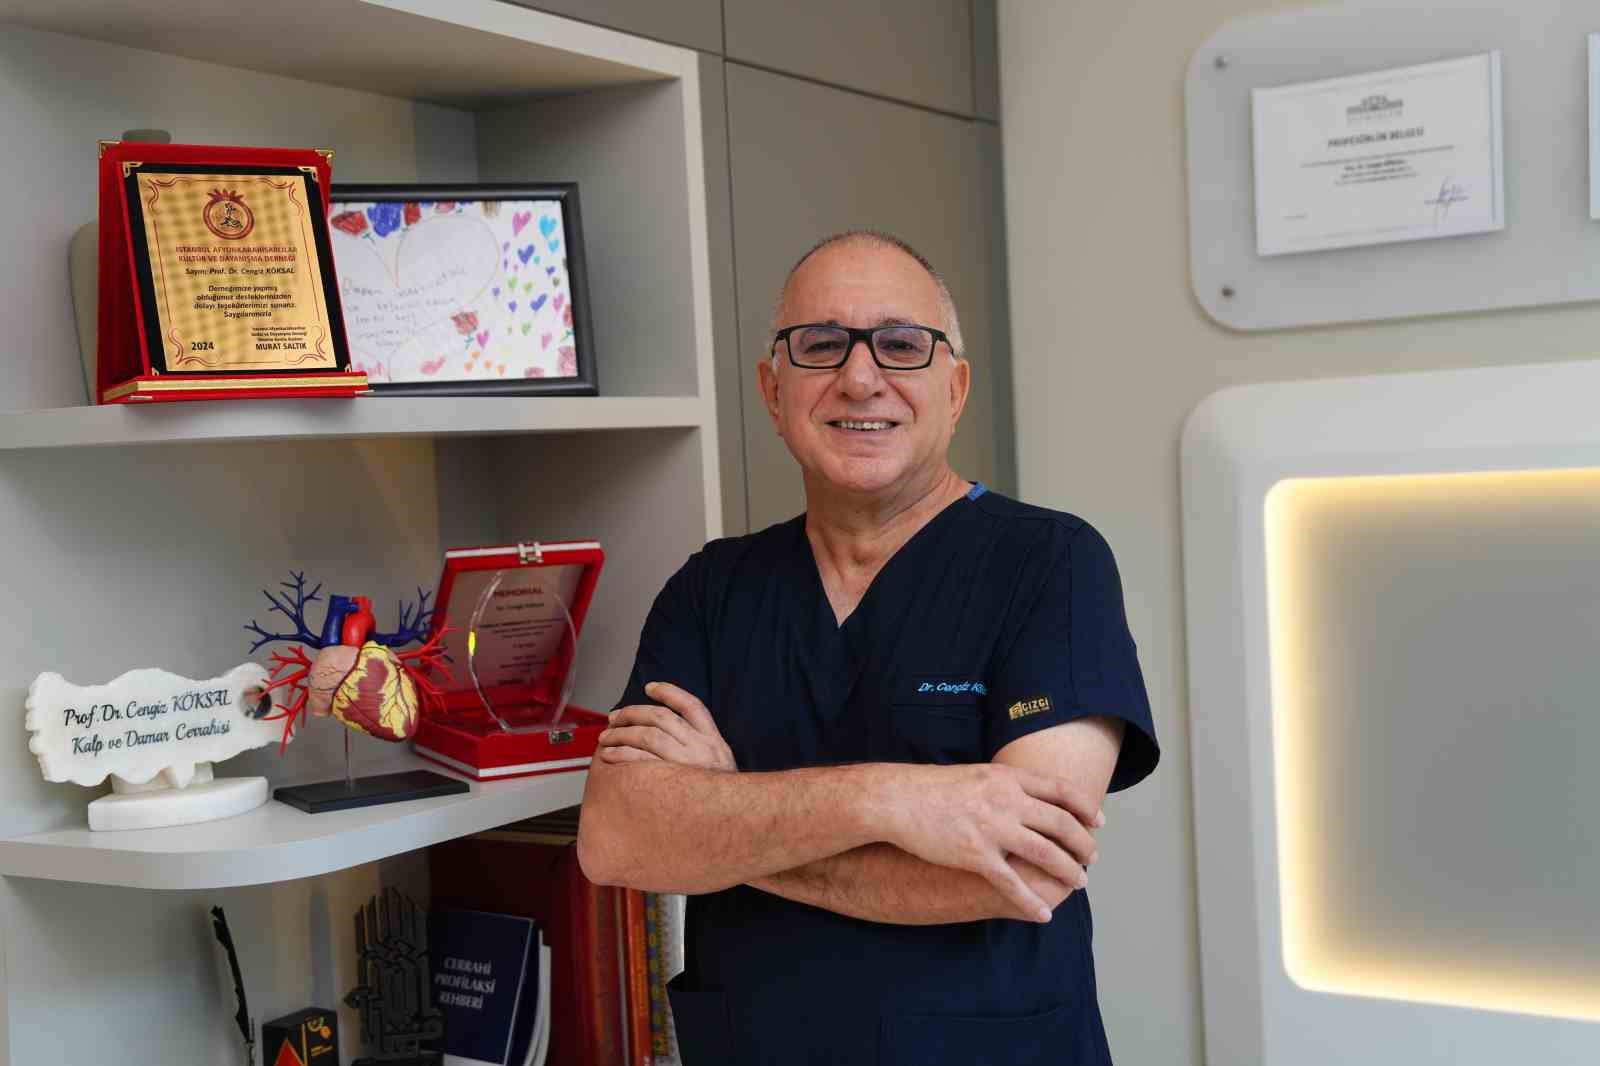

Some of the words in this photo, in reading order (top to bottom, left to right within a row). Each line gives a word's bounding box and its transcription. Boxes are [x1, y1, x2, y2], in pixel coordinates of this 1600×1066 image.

[191, 341, 215, 351] 2024
[63, 704, 99, 729] Prof.
[101, 704, 124, 721] Dr.
[126, 700, 168, 720] Cengiz
[171, 689, 232, 712] KÖKSAL
[72, 734, 103, 757] Kalp
[108, 738, 122, 749] ve
[123, 730, 169, 748] Damar
[175, 718, 231, 740] Cerrahisi
